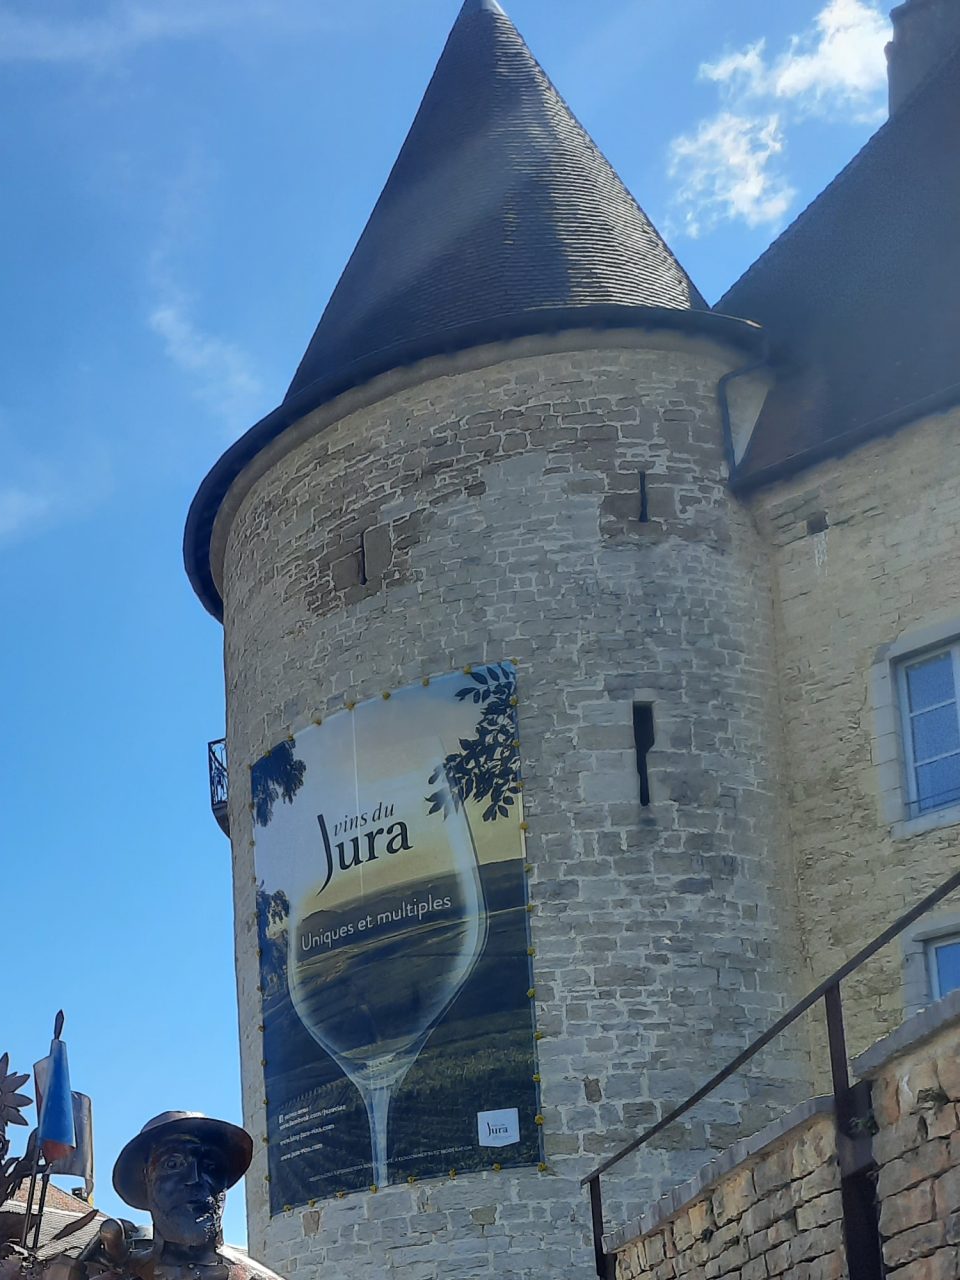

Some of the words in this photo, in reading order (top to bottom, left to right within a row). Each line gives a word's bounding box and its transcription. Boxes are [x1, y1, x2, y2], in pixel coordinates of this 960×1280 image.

[334, 812, 368, 837] vins
[372, 802, 395, 822] du
[316, 813, 414, 897] Jura
[301, 923, 354, 950] Uniques
[358, 915, 373, 931] et
[377, 894, 452, 925] multiples
